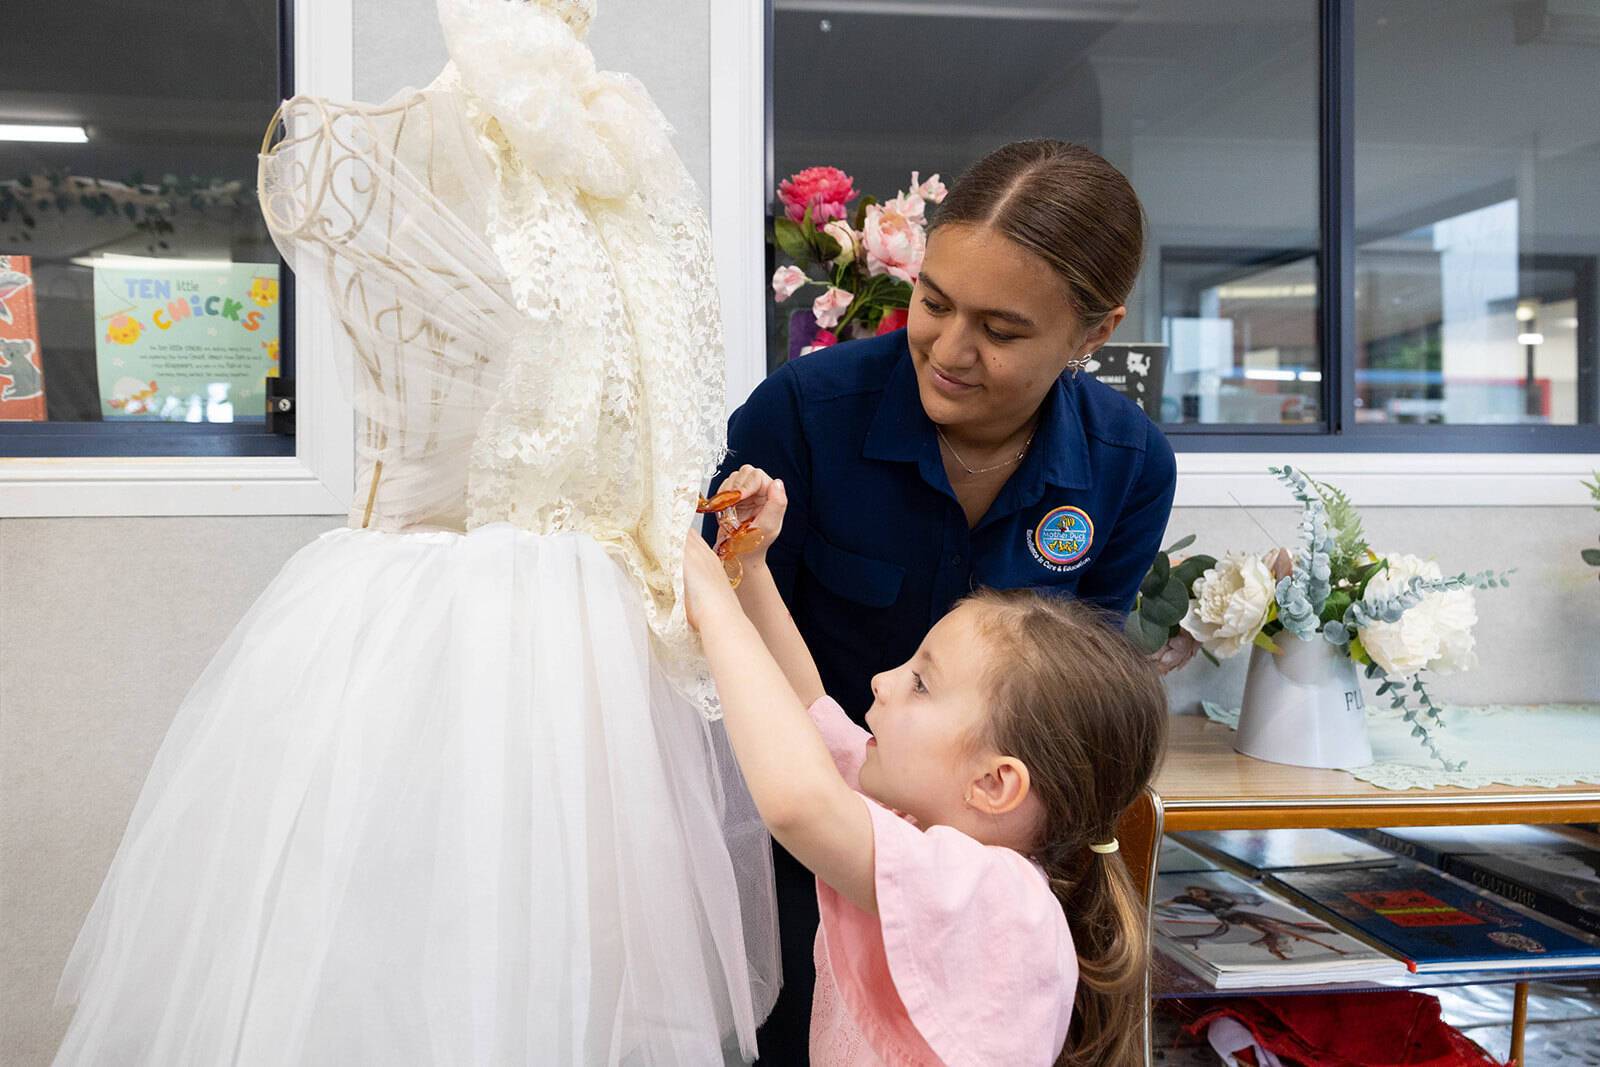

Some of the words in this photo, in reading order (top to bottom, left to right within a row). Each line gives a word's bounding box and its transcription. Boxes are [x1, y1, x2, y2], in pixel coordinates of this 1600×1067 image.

[124, 278, 170, 299] TEN
[176, 279, 200, 292] little
[1070, 532, 1086, 541] Duck
[1043, 561, 1057, 571] Care
[1063, 557, 1091, 572] Education
[1472, 870, 1536, 909] COUTURE
